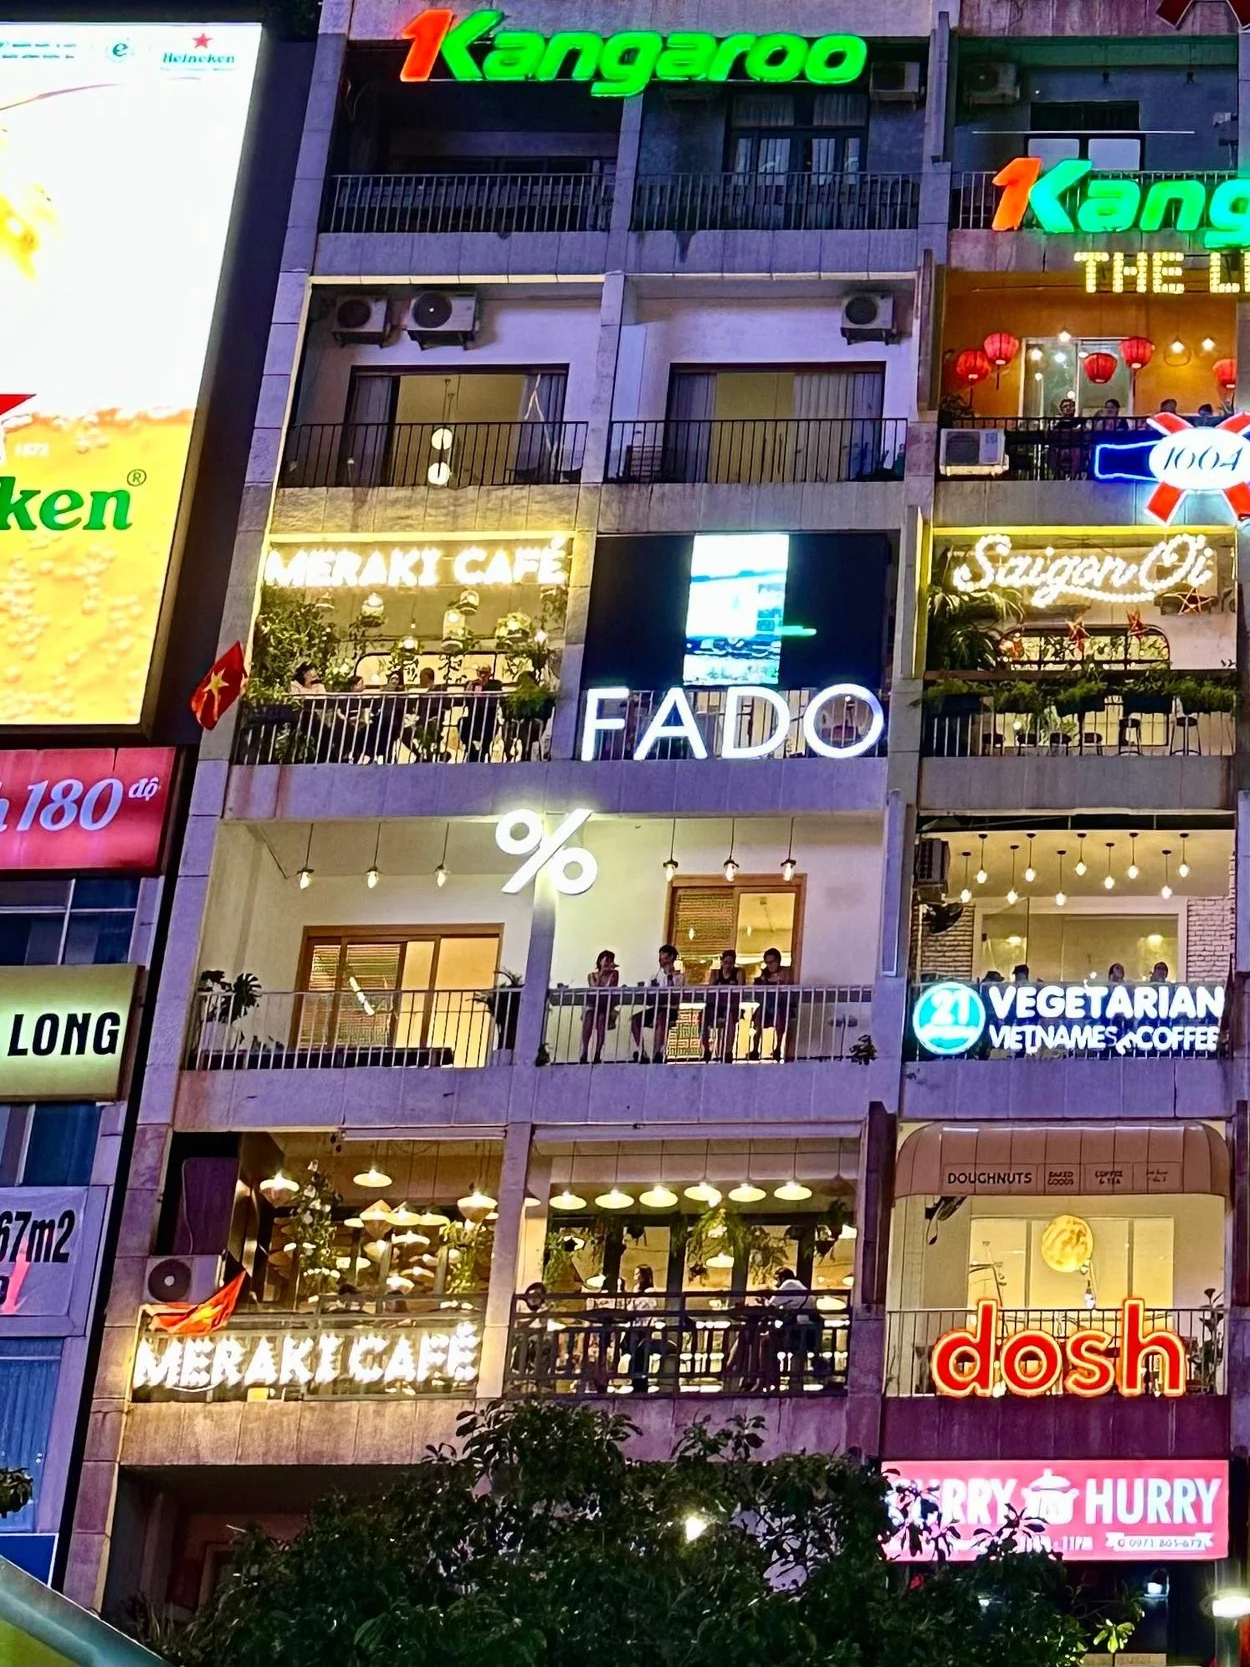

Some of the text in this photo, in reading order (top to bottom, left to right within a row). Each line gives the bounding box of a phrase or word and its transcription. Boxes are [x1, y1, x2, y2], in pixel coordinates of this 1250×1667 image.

[162, 51, 236, 64] Heineken
[1073, 251, 1185, 295] THE
[264, 536, 570, 588] MERAKI CAFÉ
[952, 534, 1140, 609] Saigon
[581, 682, 885, 762] FADO
[16, 777, 124, 832] 180
[930, 988, 971, 1025] 21
[987, 984, 1226, 1020] VEGETARIAN
[7, 1011, 121, 1057] LONG
[1135, 1026, 1220, 1052] COFFEE
[947, 1172, 1032, 1185] DOUGHNUTS
[132, 1319, 480, 1389] MERAKI CAFÉ
[931, 1296, 1189, 1398] dosh
[1084, 1477, 1223, 1525] HURRY
